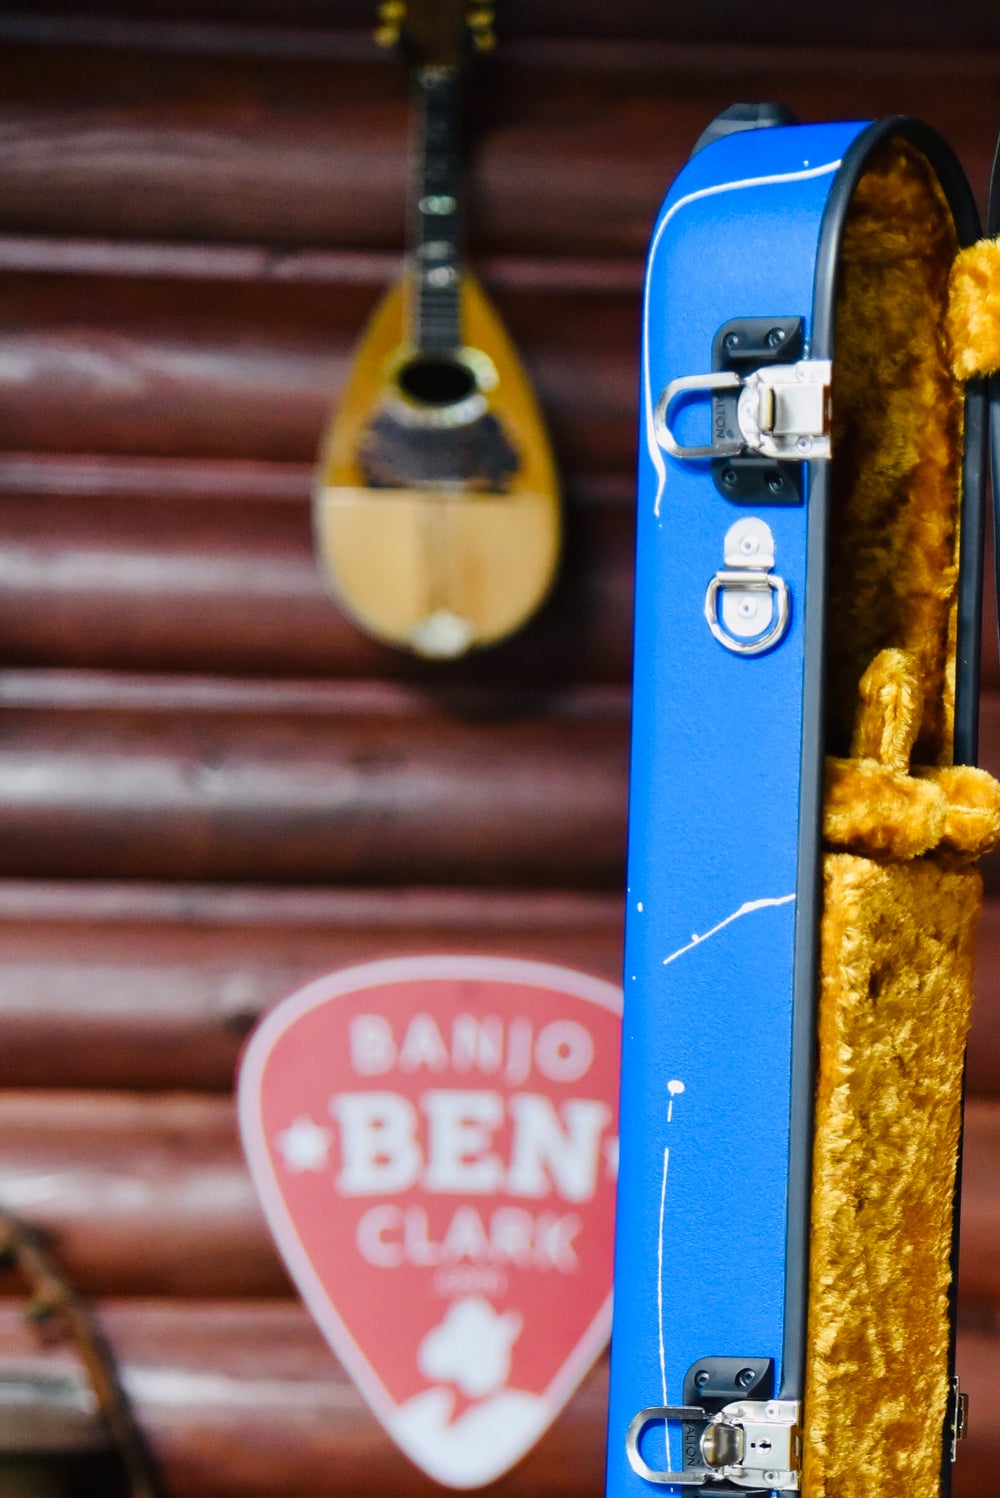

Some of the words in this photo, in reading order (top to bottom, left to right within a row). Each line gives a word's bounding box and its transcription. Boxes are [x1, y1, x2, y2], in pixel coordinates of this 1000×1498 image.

[349, 1012, 594, 1085] BANJO
[329, 1088, 612, 1203] BEN
[355, 1204, 583, 1274] CLARK
[685, 1424, 697, 1467] ALTON
